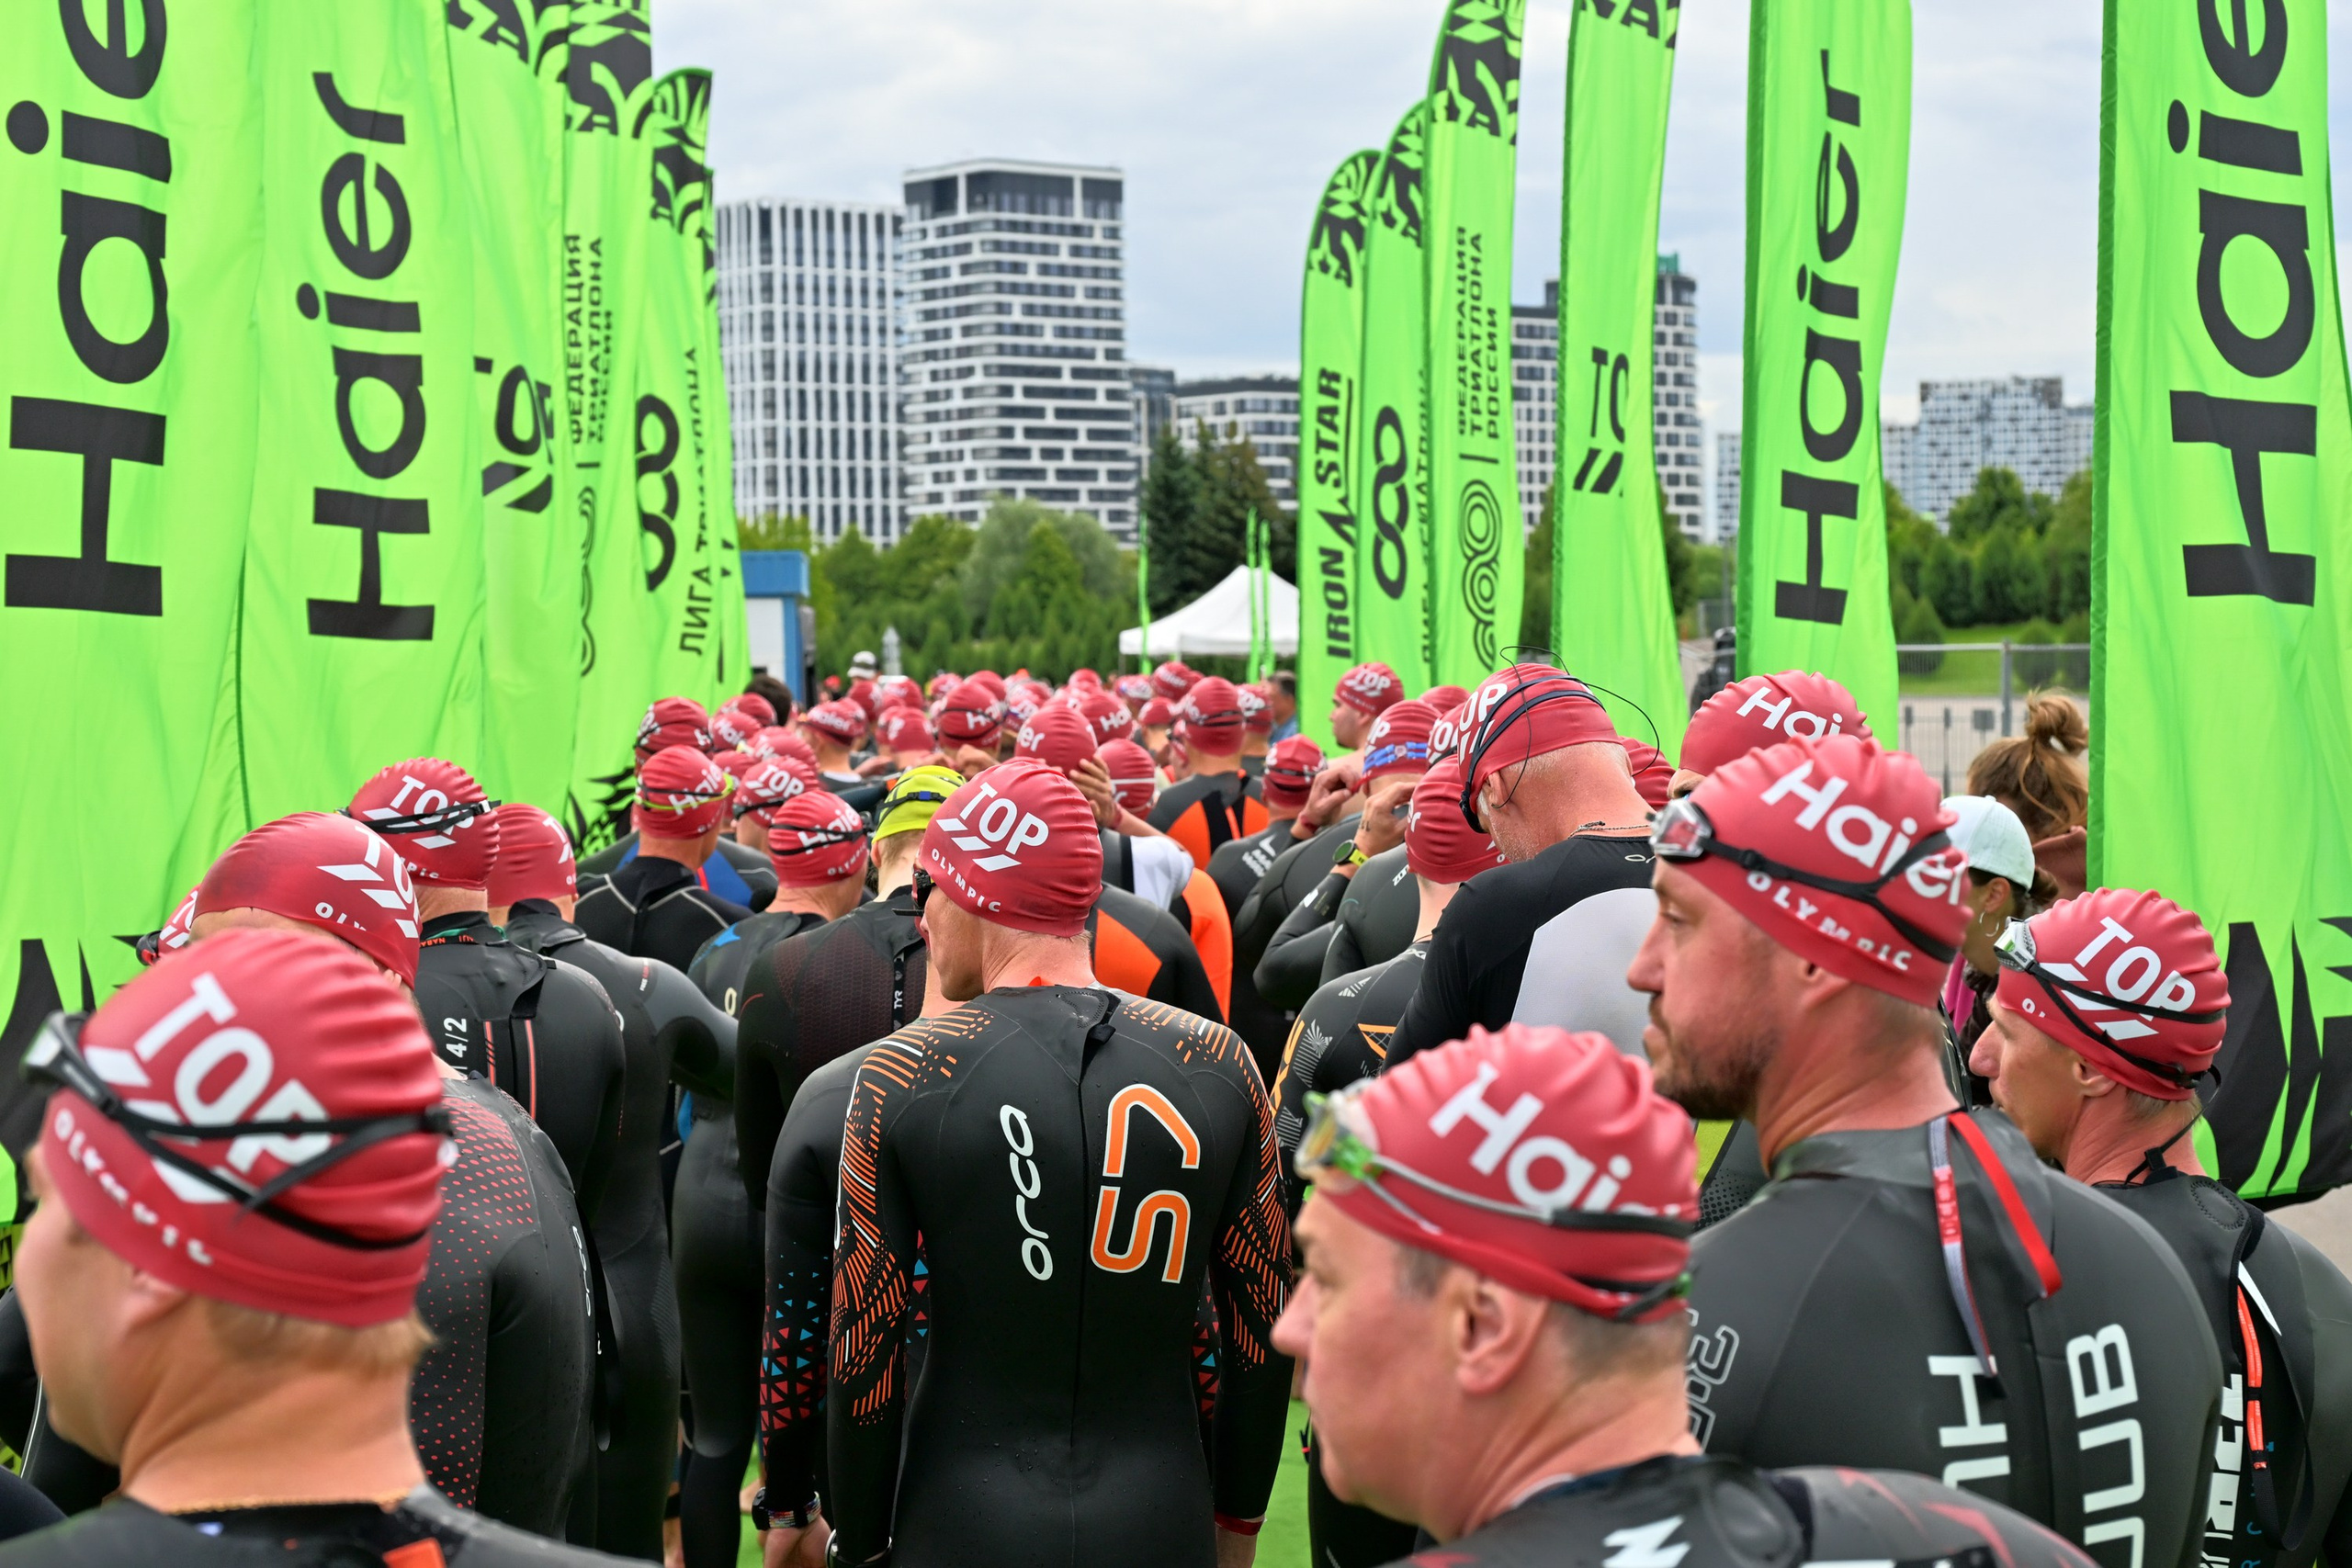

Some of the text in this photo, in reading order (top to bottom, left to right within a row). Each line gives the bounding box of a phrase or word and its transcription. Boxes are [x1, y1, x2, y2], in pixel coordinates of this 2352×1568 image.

[5, 0, 172, 616] Haie
[296, 72, 435, 641] Haier
[564, 234, 584, 445] ФЕДЕРАЦИЯ
[1469, 231, 1484, 437] ТРИАТЛОНА
[1774, 49, 1863, 626] Haier
[2166, 0, 2319, 607] Haie
[1487, 307, 1500, 440] РОССИИ
[1590, 345, 1630, 444] TO
[1314, 367, 1353, 659] IRON STAR
[679, 565, 713, 657] ЛИГА
[1459, 682, 1508, 732] OP
[1736, 686, 1843, 742] Hai
[758, 764, 805, 798] TOP
[959, 782, 1049, 855] TOP
[355, 825, 419, 925] TO
[931, 848, 1001, 913] OLYMPIC
[894, 990, 903, 1010] TYR
[2075, 916, 2196, 1021] TOP
[134, 972, 332, 1174] TOP
[443, 1017, 469, 1058] 4/2
[1000, 1104, 1054, 1281] orca
[1429, 1061, 1680, 1217] Hai
